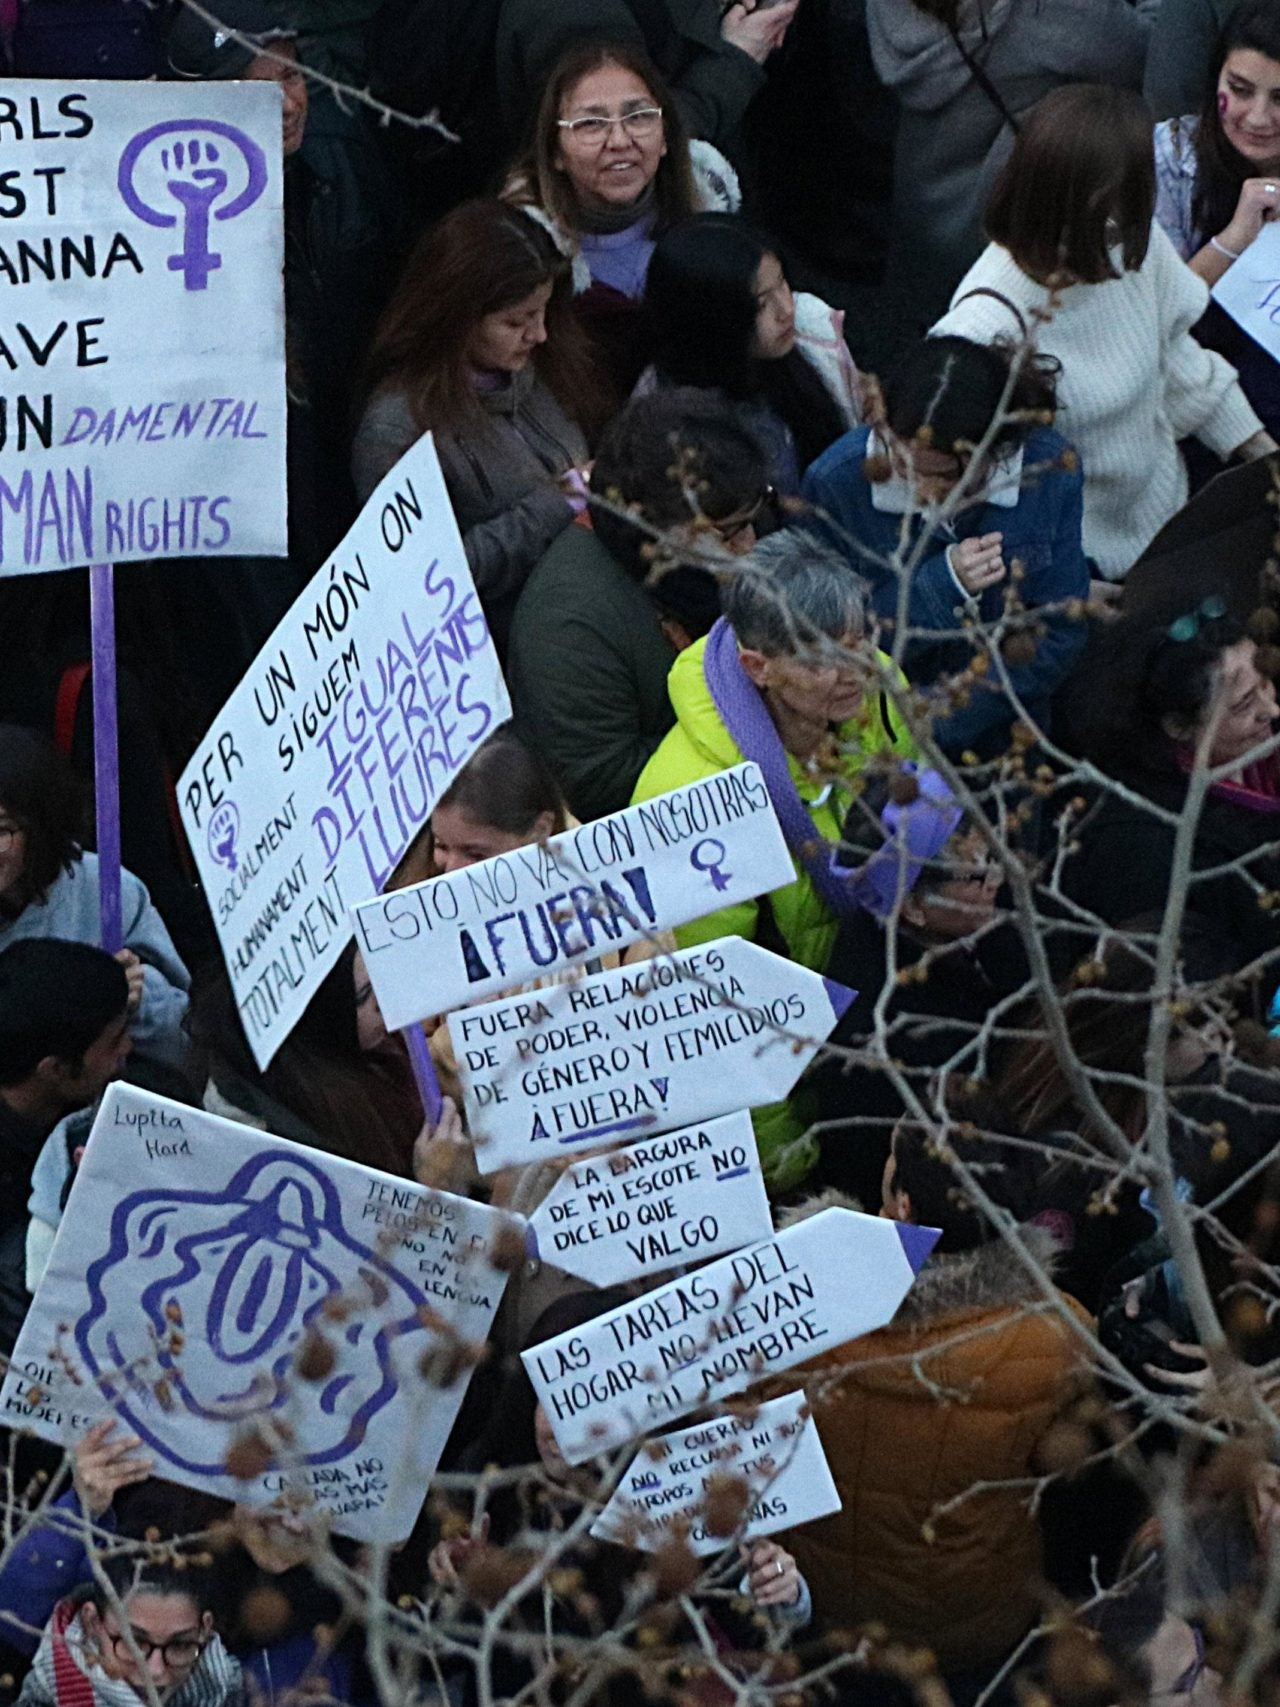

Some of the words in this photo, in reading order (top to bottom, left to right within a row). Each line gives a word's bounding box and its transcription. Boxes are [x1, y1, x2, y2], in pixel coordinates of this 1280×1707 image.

[106, 495, 233, 554] RIGHTS
[183, 731, 244, 829] PER
[254, 650, 296, 726] UN
[303, 553, 370, 661] MÓN
[381, 477, 423, 552] ON
[220, 791, 298, 926] SOCIALMENT
[316, 558, 455, 791] IGUALS
[311, 592, 490, 868] DIFERENTS
[239, 865, 345, 1037] TOTALMENT
[359, 673, 491, 895] LLIURES
[355, 880, 460, 953] ESTO
[469, 857, 518, 912] NO
[526, 836, 569, 891] VA
[574, 817, 634, 878] CON
[639, 765, 770, 851] NOSOTRAS
[461, 1000, 553, 1042] FUERA
[569, 949, 725, 1013] RELACIONES
[466, 1046, 500, 1072] DE
[616, 975, 745, 1032] VIOLENCIA
[474, 1080, 508, 1107] DE
[522, 1045, 630, 1098] GÉNERO
[633, 1040, 651, 1069] Y
[664, 993, 806, 1062] FEMICIDIOS
[114, 1105, 186, 1137] Lupita
[549, 1199, 580, 1223] DE
[622, 1160, 701, 1200] ESCOTE
[711, 1146, 747, 1173] NO
[572, 1168, 601, 1189] LA
[608, 1131, 712, 1177] LARGURA
[368, 1179, 456, 1221] TENEMOS
[429, 1222, 459, 1245] EN
[553, 1219, 604, 1250] DICE
[606, 1210, 631, 1233] LO
[637, 1197, 678, 1225] QUE
[419, 1259, 447, 1276] EN
[626, 1215, 719, 1264] VALGO
[536, 1337, 591, 1384] LAS
[602, 1276, 720, 1352] TAREAS
[731, 1242, 800, 1295] DEL
[550, 1359, 643, 1421] HOGAR
[658, 1334, 697, 1370] NO
[711, 1273, 815, 1344] LLEVAN
[15, 1380, 52, 1404] LS
[645, 1385, 683, 1418] MI
[700, 1309, 829, 1389] NOMBRE
[355, 1457, 384, 1477] NO
[631, 1471, 659, 1490] NO
[752, 1432, 772, 1450] NI
[738, 1453, 775, 1474] TUS
